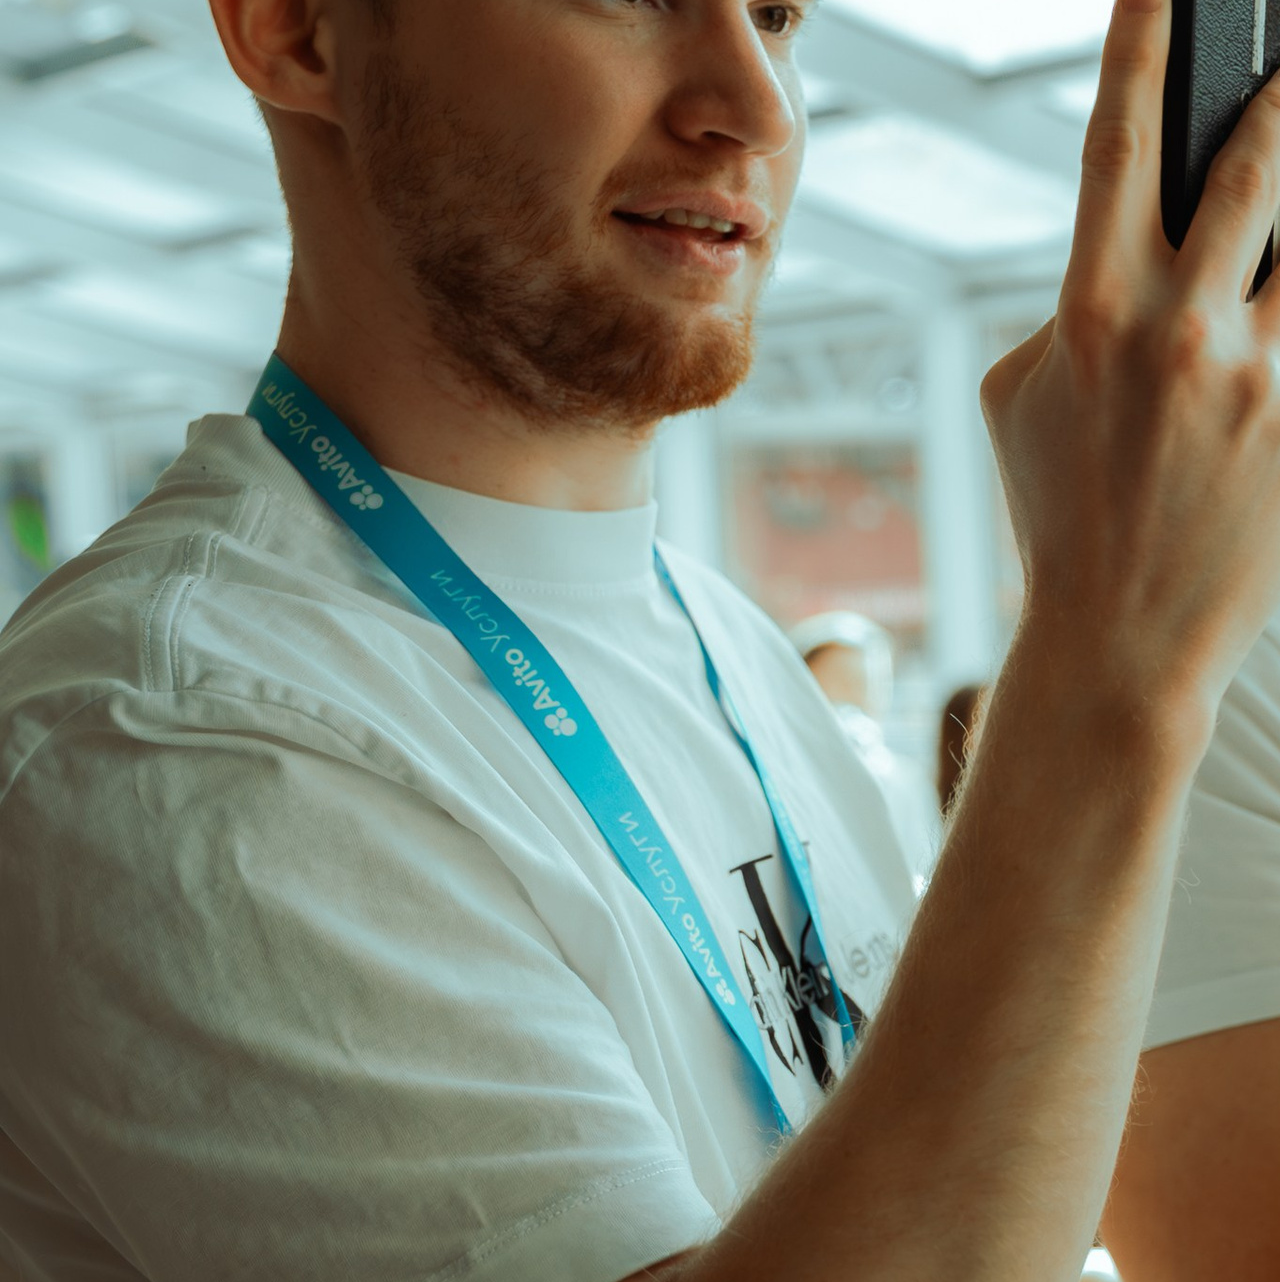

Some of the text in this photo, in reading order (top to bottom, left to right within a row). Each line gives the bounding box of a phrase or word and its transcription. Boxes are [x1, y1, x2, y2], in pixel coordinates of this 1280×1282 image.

[262, 381, 366, 490] Avito Услуги
[430, 569, 561, 711] Avito Услуги
[618, 811, 722, 978] Avito Услуги
